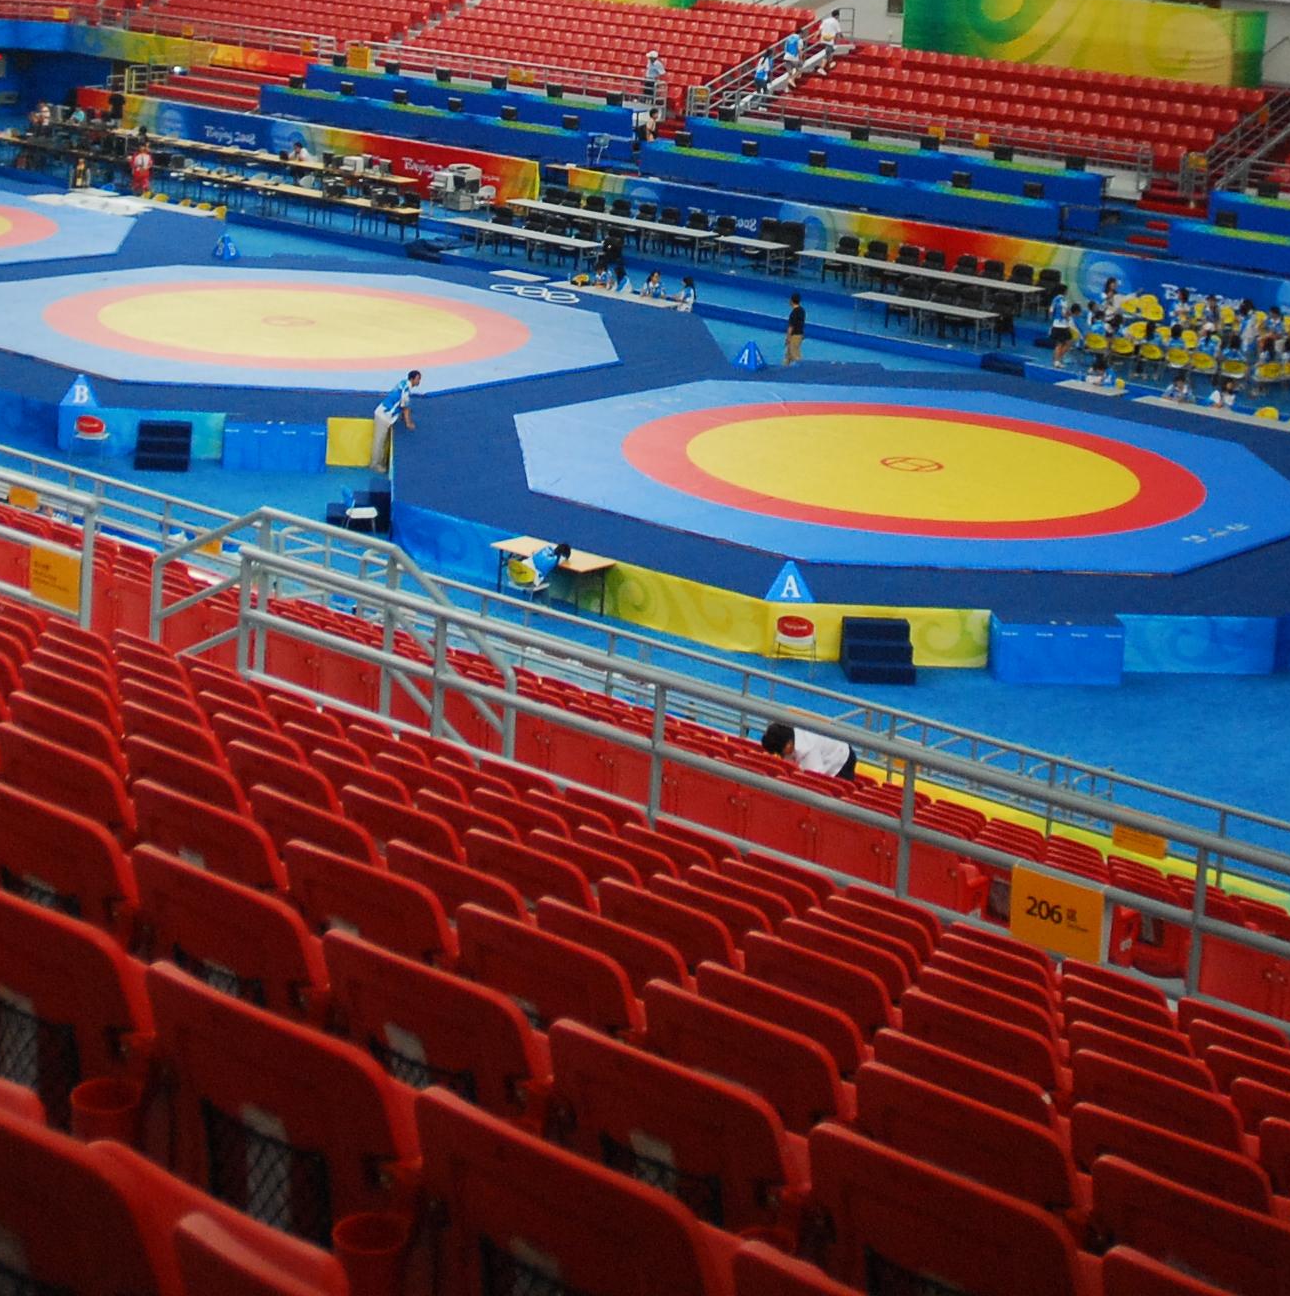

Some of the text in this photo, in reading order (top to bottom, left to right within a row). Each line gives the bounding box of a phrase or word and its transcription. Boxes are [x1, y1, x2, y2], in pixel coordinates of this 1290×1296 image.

[73, 384, 89, 404] B
[780, 574, 802, 599] A
[1026, 895, 1063, 924] 206
